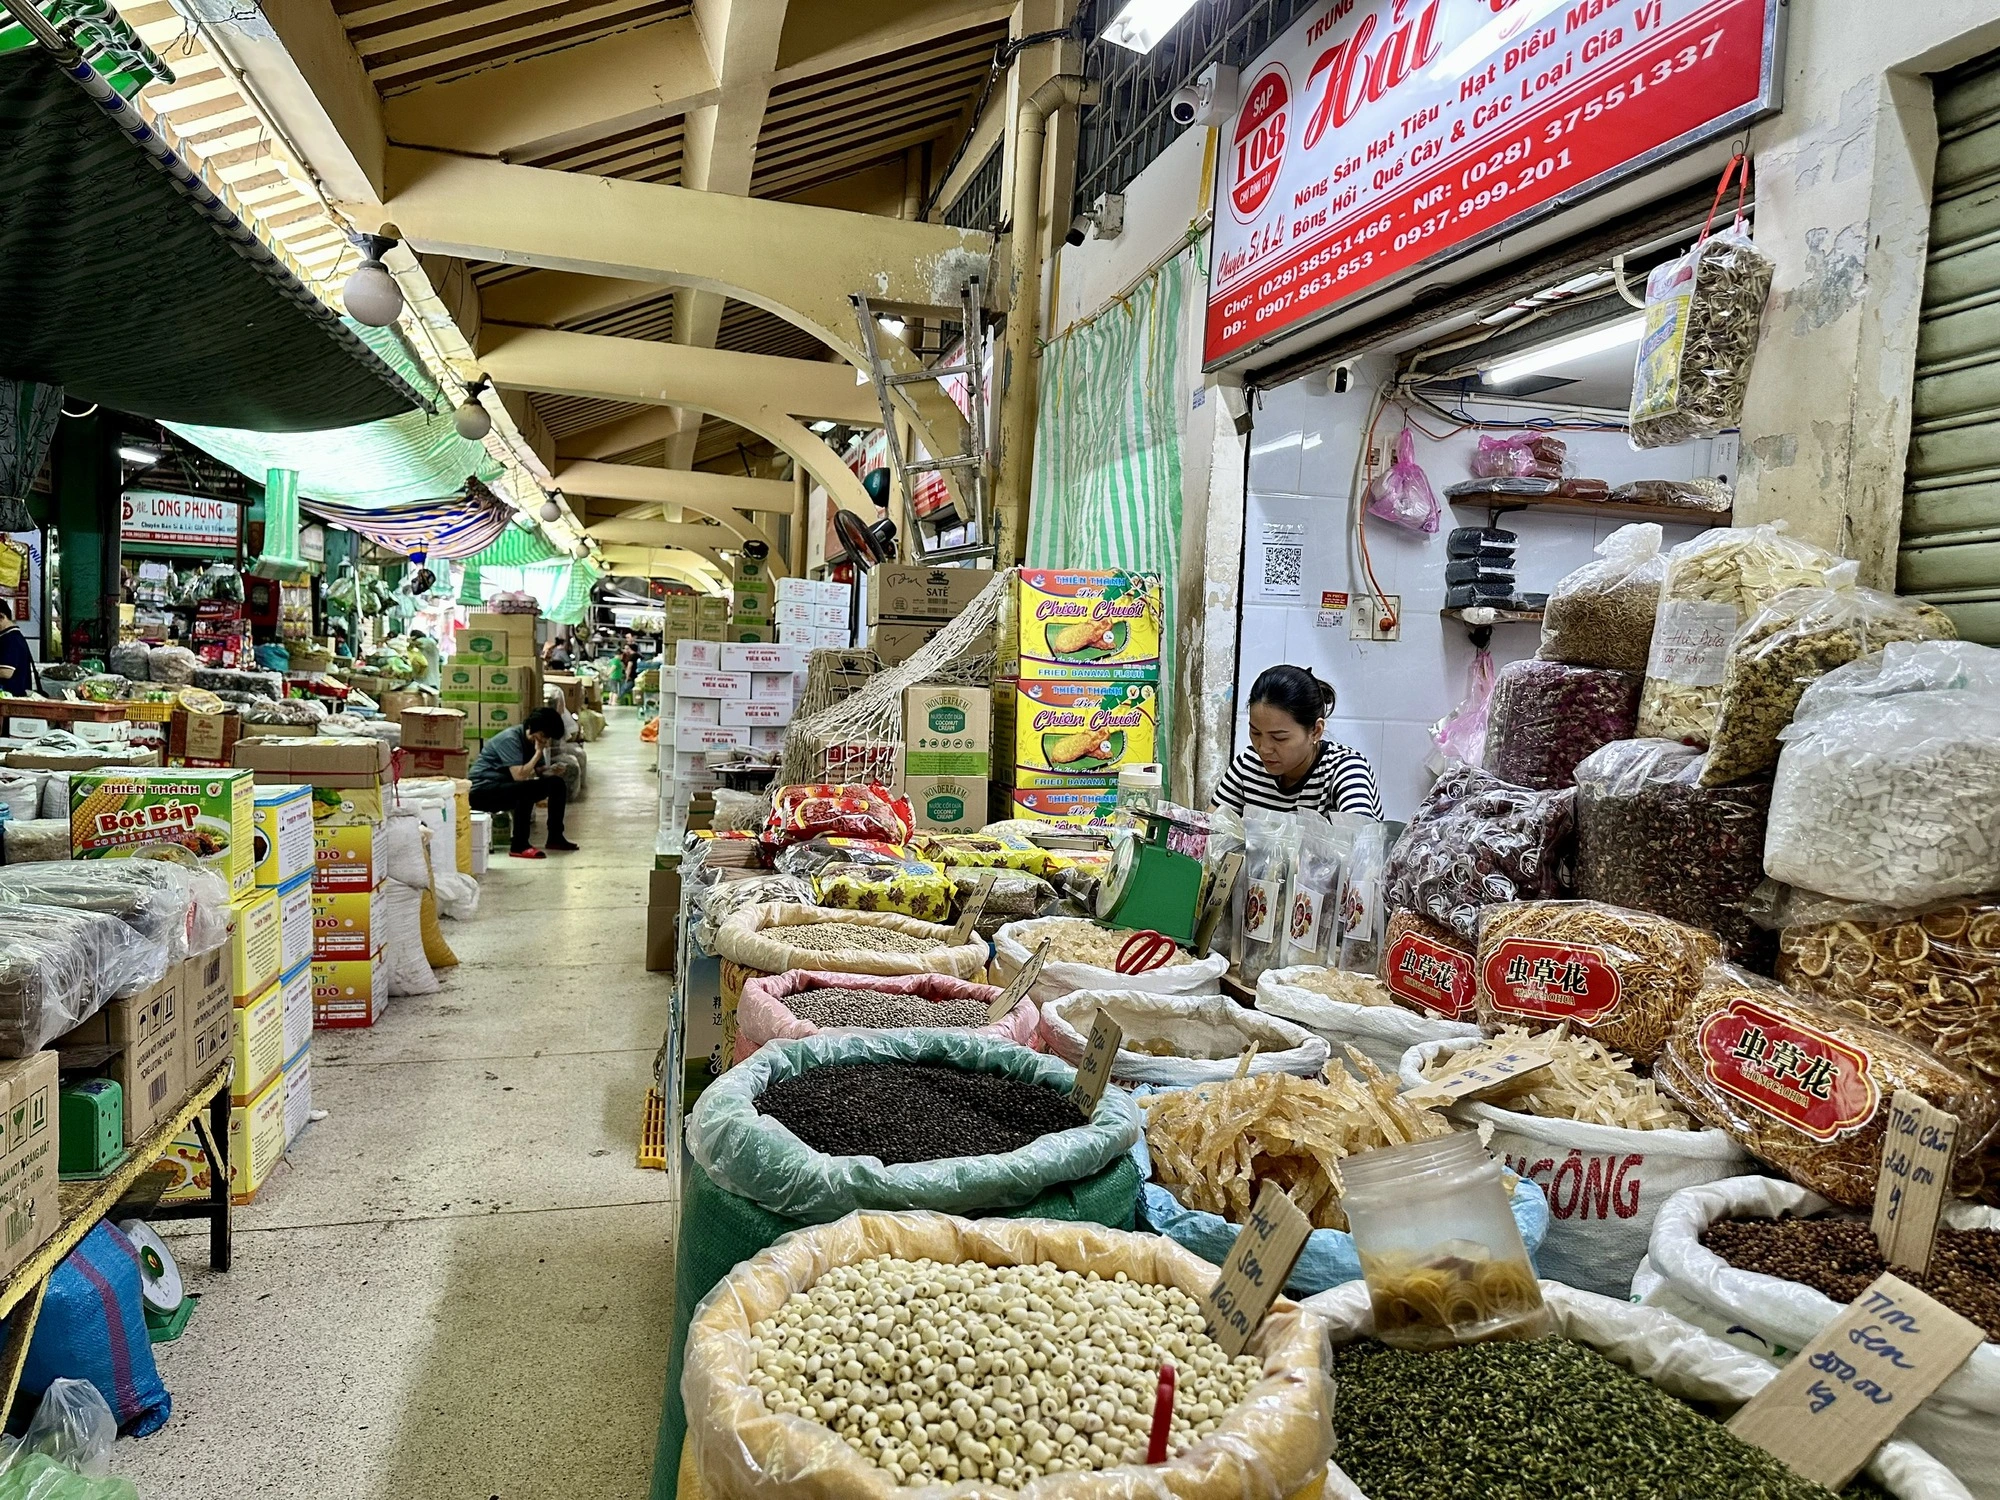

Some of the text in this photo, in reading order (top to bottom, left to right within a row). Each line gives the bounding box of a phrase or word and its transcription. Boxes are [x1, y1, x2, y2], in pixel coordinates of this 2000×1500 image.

[1252, 84, 1274, 117] SẠP
[1292, 208, 1327, 239] Bông
[1332, 184, 1357, 215] Hồi
[1372, 150, 1407, 190] Quế
[1410, 136, 1444, 168] Cây
[1450, 119, 1466, 144] &
[1472, 96, 1513, 130] Các
[1520, 51, 1573, 103] Loại
[1581, 27, 1623, 64] Gia
[1633, 0, 1662, 32] Vị
[1294, 176, 1329, 210] Nông
[1333, 157, 1361, 184] Sản
[1366, 130, 1395, 163] Hạt
[1400, 103, 1440, 140] Tiêu
[1459, 63, 1497, 102] Hạt
[1503, 27, 1556, 74] Điều
[1235, 112, 1286, 185] 108
[1224, 294, 1253, 318] Chợ:
[1413, 183, 1452, 215] NR:
[1461, 136, 1532, 191] (028)
[1543, 28, 1725, 144] 37551337
[1217, 246, 1247, 286] Chuyên
[1261, 222, 1270, 255] &
[1222, 318, 1247, 340] DĐ:
[1255, 250, 1374, 323] 0907.863.853
[1393, 147, 1573, 253] 0937.999.201
[151, 498, 223, 524] LONG PHỤNG
[1036, 600, 1146, 620] Chiên Chuối
[1038, 668, 1145, 679] FRIED BANANA FLOUR
[1051, 685, 1084, 696] THIÊN
[925, 695, 969, 711] WONDERFARM
[1033, 710, 1142, 731] Chiên Chuối
[102, 782, 199, 795] THIÊN THÀNH
[923, 784, 968, 799] WONDERFARM
[1034, 778, 1063, 786] FRIED
[1067, 778, 1106, 786] BANANA
[1046, 794, 1079, 804] THIÊN
[98, 799, 200, 834] Bột Bắp
[1399, 947, 1458, 992] 虫草花
[1505, 954, 1590, 996] 虫草花
[1732, 1026, 1840, 1100] 虫草花
[1740, 1065, 1810, 1108] CHONGCAOHUA
